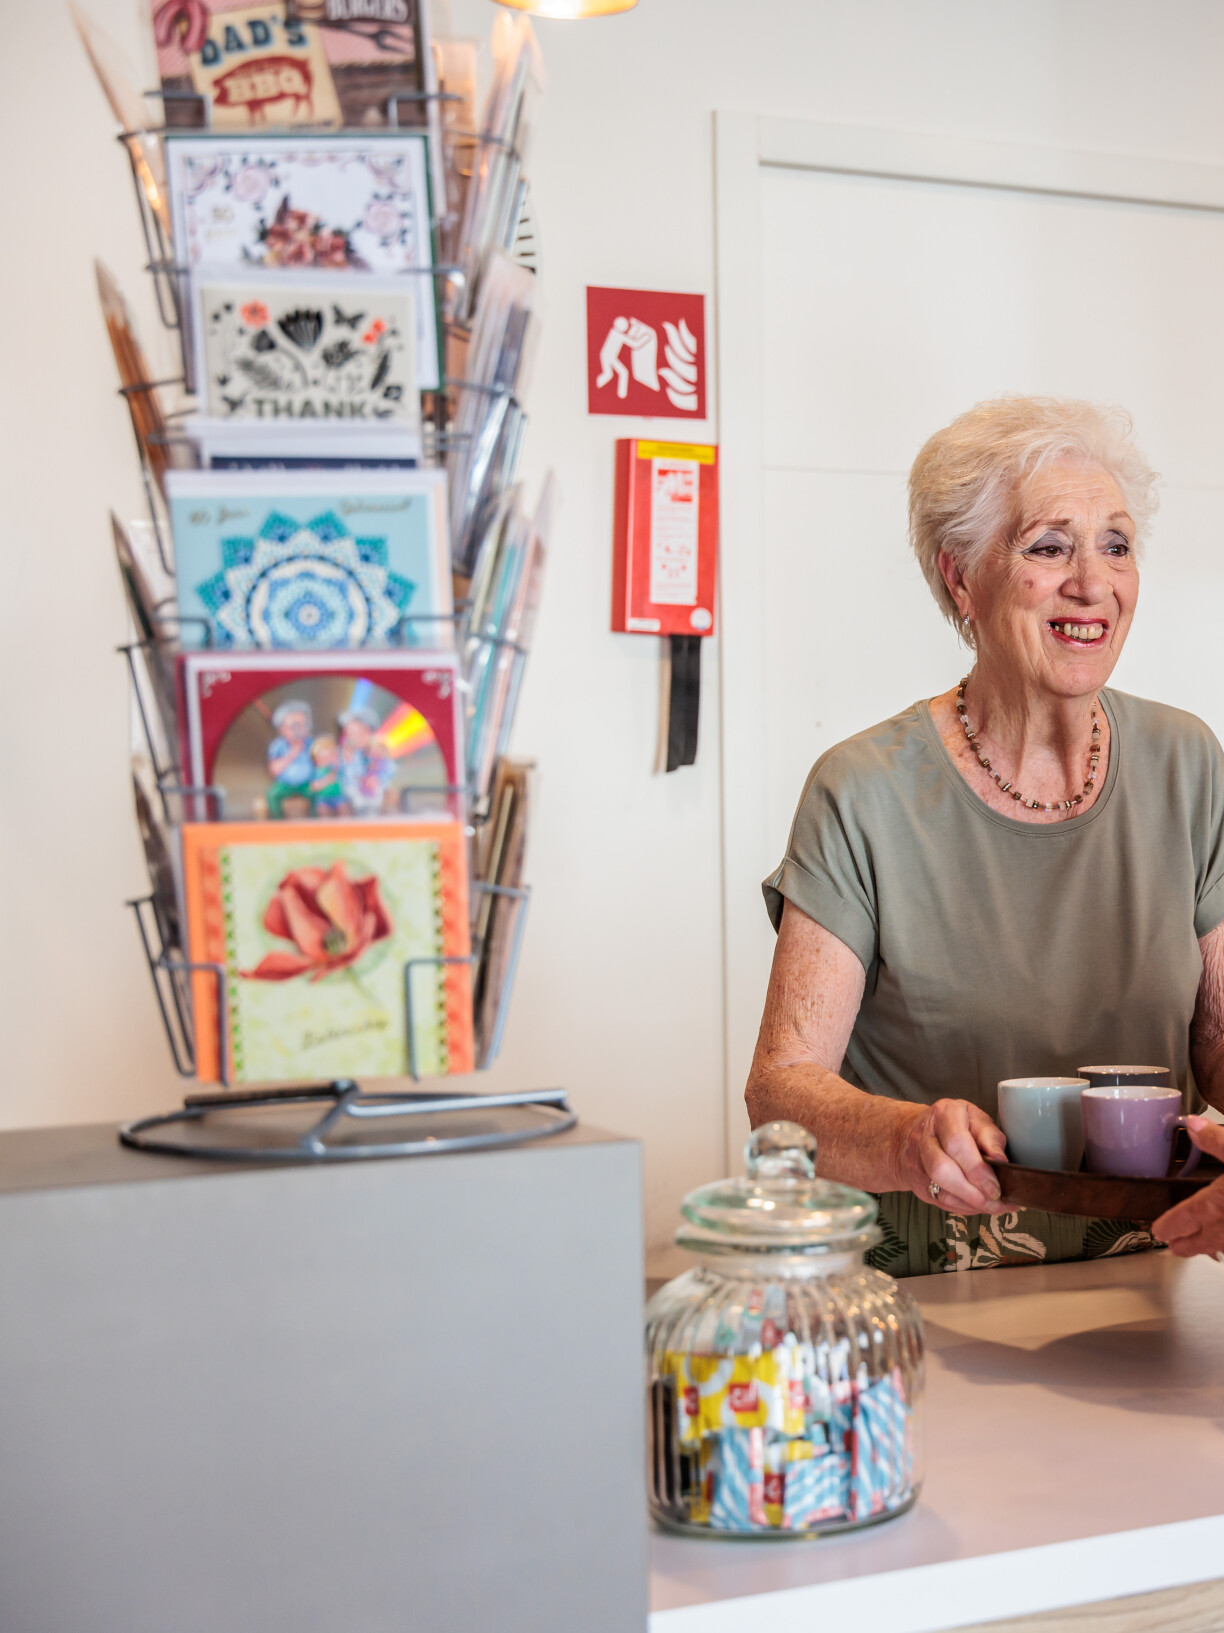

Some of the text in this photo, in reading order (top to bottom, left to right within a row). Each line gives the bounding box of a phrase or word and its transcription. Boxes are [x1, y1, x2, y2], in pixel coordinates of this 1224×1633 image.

[201, 14, 308, 67] DAD'S
[227, 68, 306, 102] BBQ
[252, 397, 366, 419] THANK
